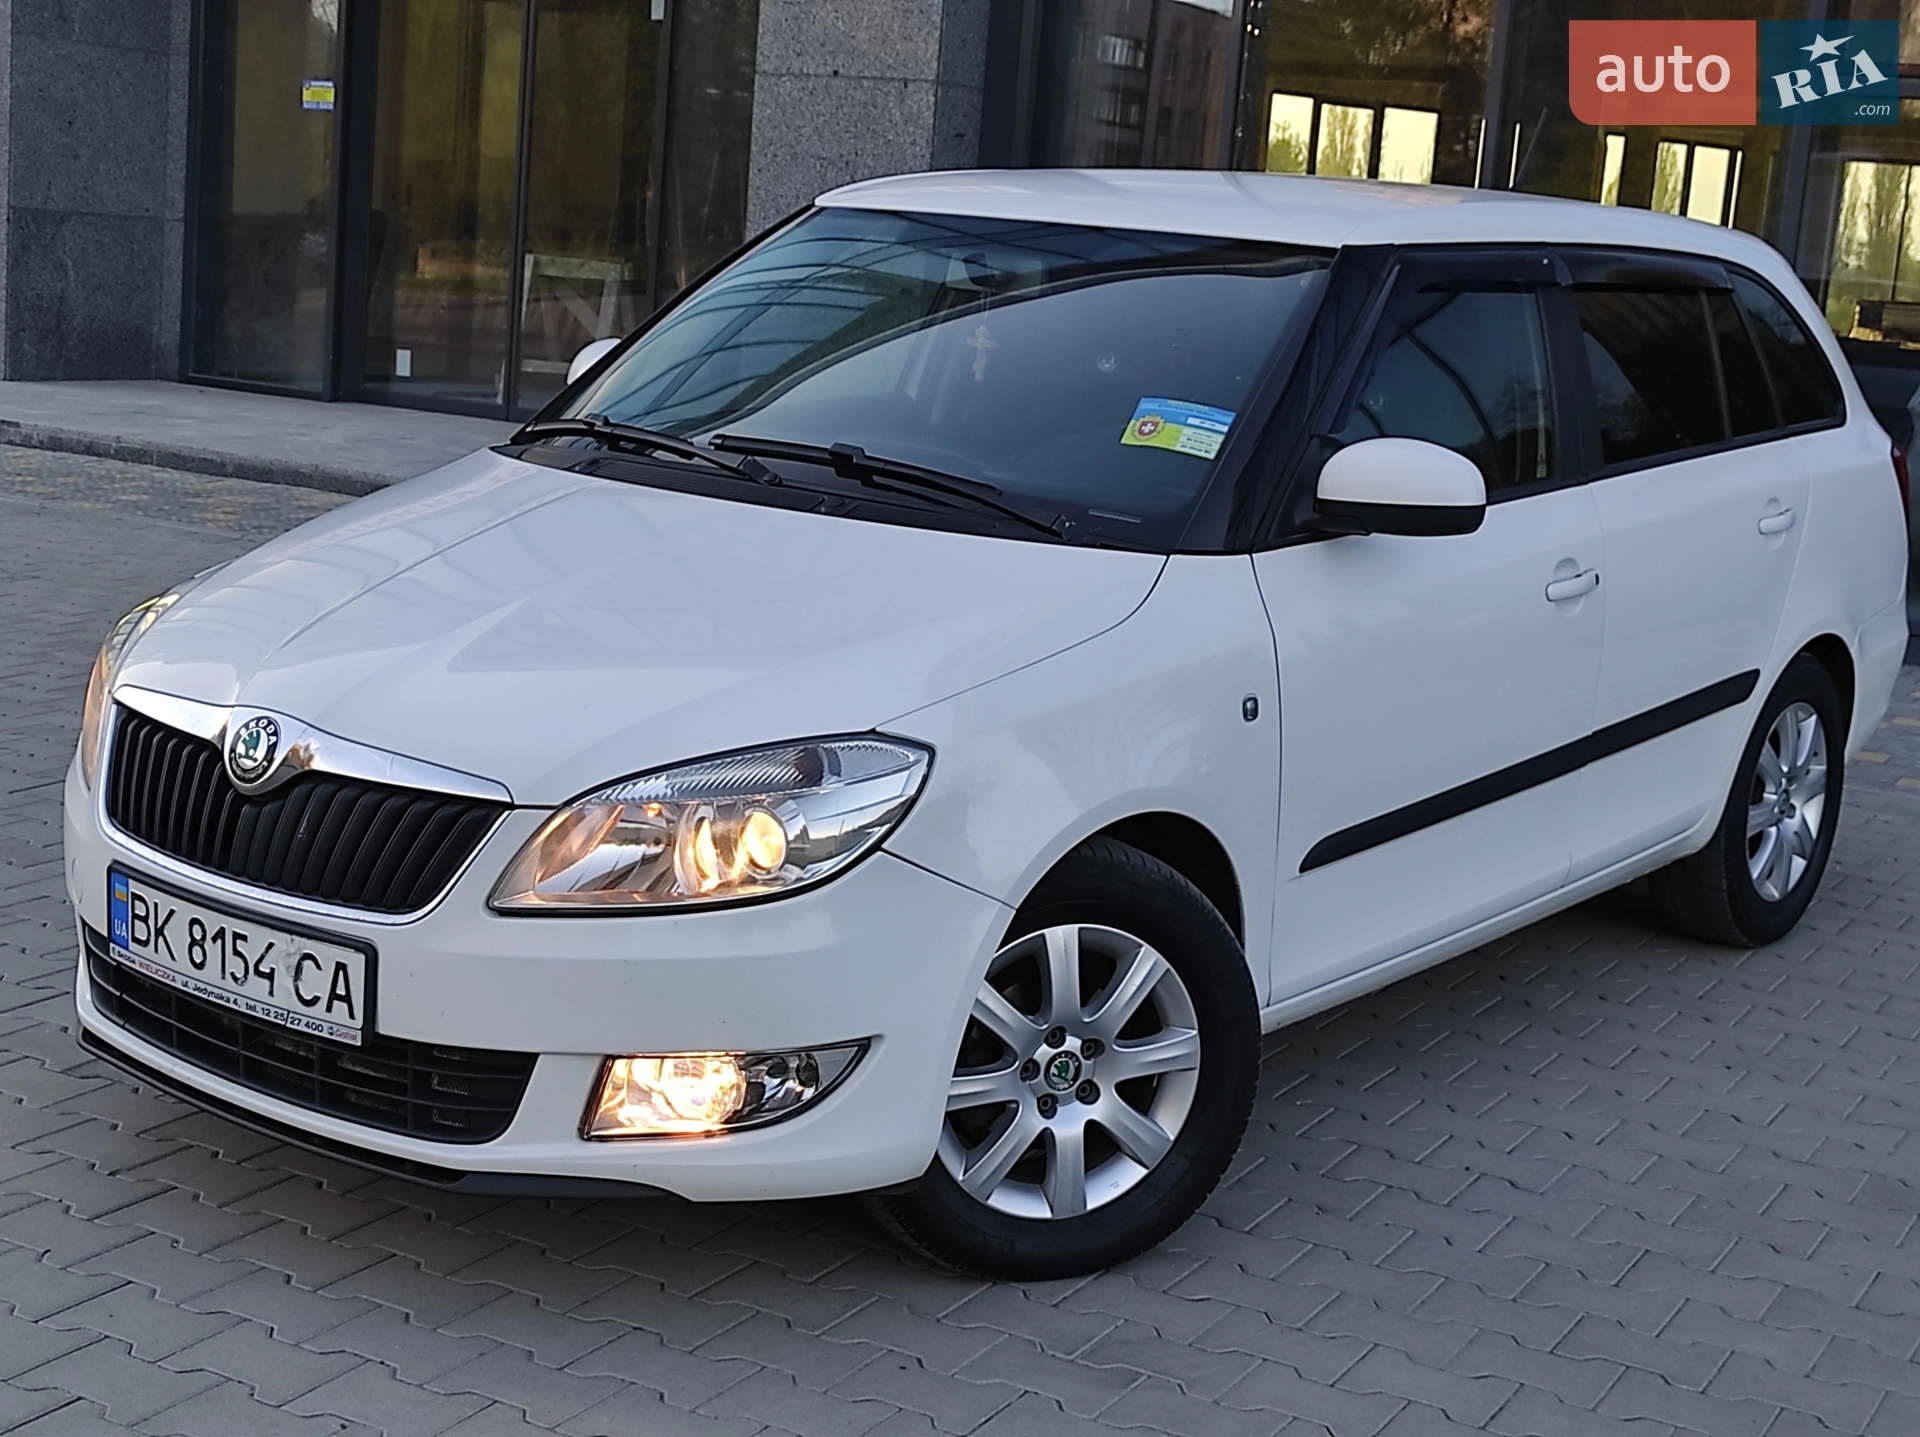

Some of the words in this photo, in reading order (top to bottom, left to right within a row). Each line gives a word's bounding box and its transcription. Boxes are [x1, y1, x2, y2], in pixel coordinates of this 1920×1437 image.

[114, 918, 128, 939] UA
[130, 890, 178, 962] BK
[187, 915, 277, 998] 8154
[293, 951, 357, 1021] CA
[139, 961, 177, 984] WIELICZKA
[245, 1001, 259, 1014] tel.
[261, 1007, 272, 1018] 12
[273, 1010, 286, 1022] 25
[289, 1016, 302, 1027] 27
[304, 1020, 324, 1033] 400
